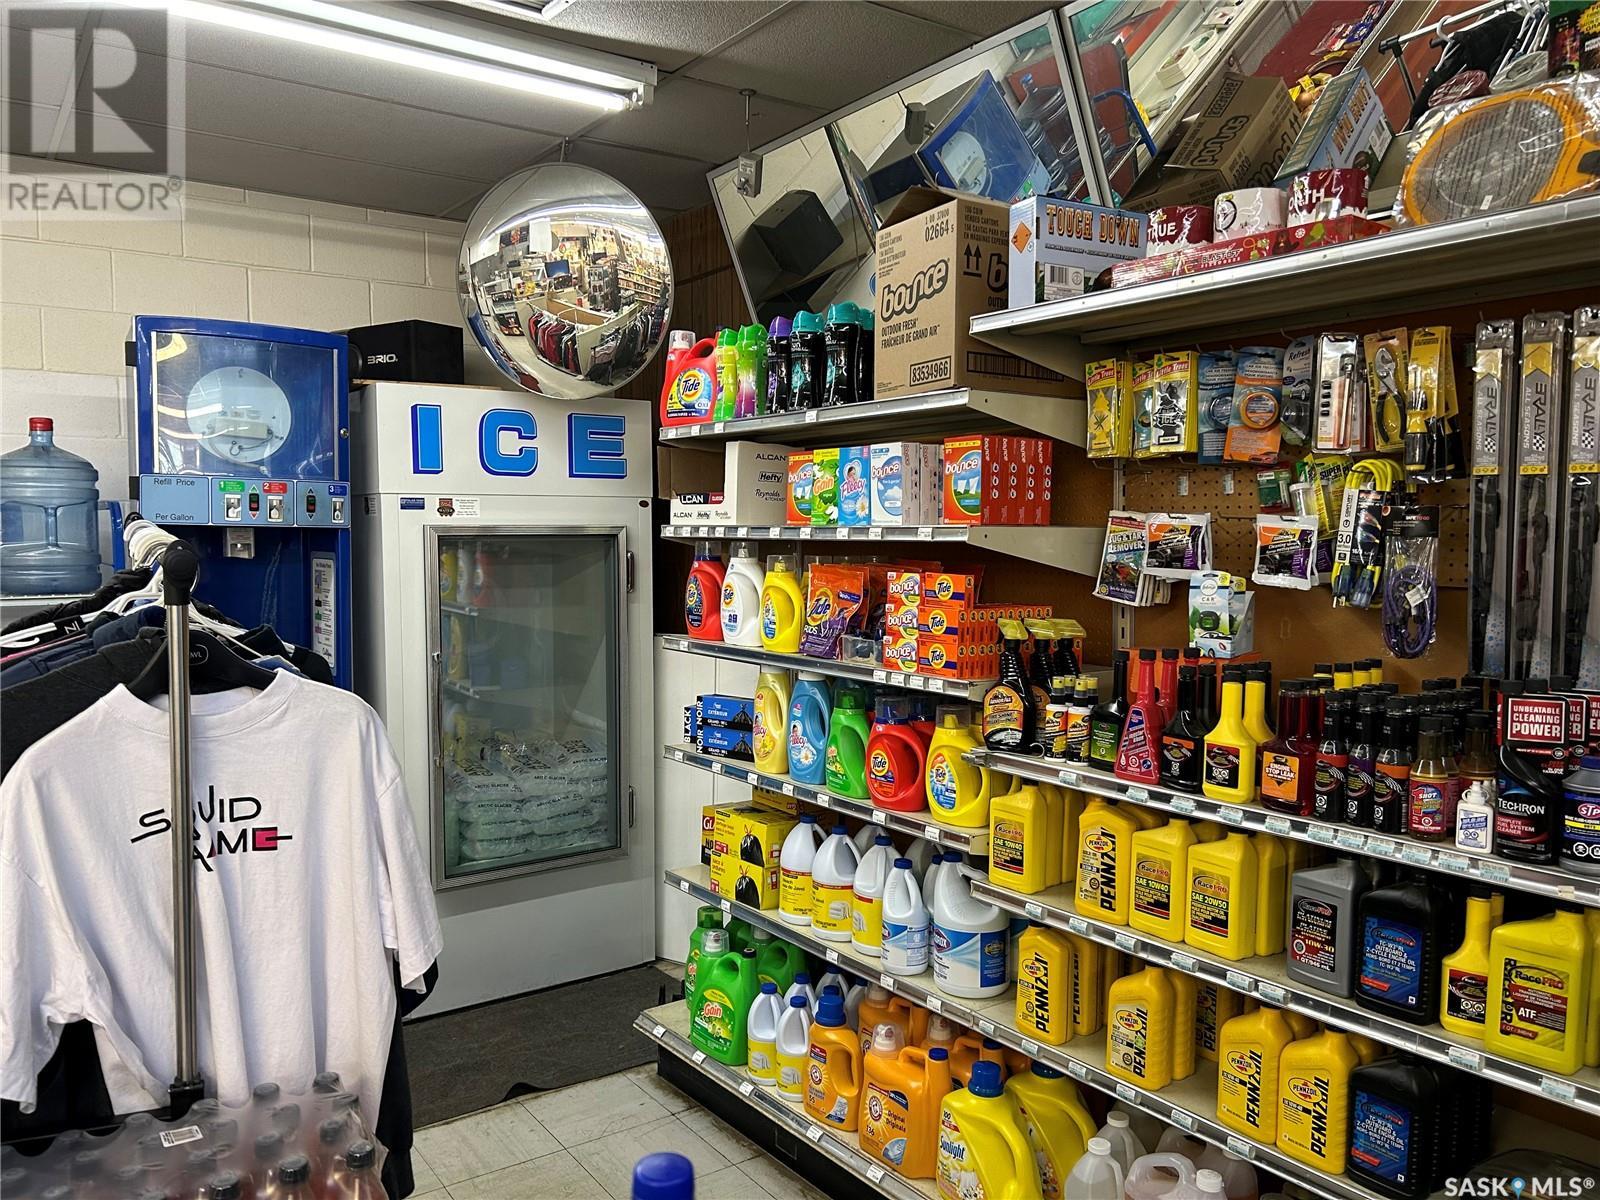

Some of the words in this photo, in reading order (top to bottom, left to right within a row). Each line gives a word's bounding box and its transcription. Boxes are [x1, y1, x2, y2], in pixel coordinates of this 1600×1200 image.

[925, 219, 949, 242] 02664
[1047, 204, 1092, 241] TOUCH
[1100, 217, 1140, 248] DOWN
[881, 259, 949, 323] bounce
[881, 322, 901, 337] OUTDOOR
[902, 319, 917, 332] FRESH
[905, 334, 911, 342] DE
[912, 329, 927, 342] GRAND
[928, 326, 938, 337] AIR
[912, 361, 948, 383] 83534966
[1172, 363, 1189, 372] Trees
[682, 379, 700, 396] Tide
[411, 403, 627, 478] ICE
[755, 453, 786, 462] ALCAN
[871, 462, 899, 478] bounce
[945, 458, 978, 474] bounce
[1319, 464, 1341, 480] SUPER
[153, 477, 172, 487] Refill
[176, 478, 195, 487] Price
[759, 472, 783, 482] Hefty
[788, 470, 812, 483] bounce
[263, 482, 270, 490] 2
[329, 485, 335, 493] 3
[813, 477, 834, 494] Gain
[840, 478, 866, 498] Fleecy
[755, 489, 781, 498] Reynolds
[155, 513, 169, 521] Per
[170, 513, 194, 521] Gallon
[1337, 534, 1352, 544] 3.0
[687, 588, 697, 600] Tide
[889, 580, 914, 594] bounce
[937, 582, 951, 595] Tide
[723, 588, 734, 601] Tide
[808, 598, 831, 617] Tide
[887, 612, 913, 627] bounce
[930, 616, 945, 629] Tide
[885, 645, 910, 659] bounce
[930, 649, 945, 662] Tide
[1513, 705, 1560, 715] UNBEATABLE
[1513, 713, 1560, 724] CLEANING
[684, 709, 692, 743] BLACK
[1512, 722, 1561, 737] POWER
[872, 755, 887, 769] Tide
[1266, 767, 1280, 775] STOP
[1281, 770, 1295, 778] LEAK
[1498, 797, 1545, 815] TECHRON
[1581, 803, 1600, 816] STP
[131, 785, 262, 843] SUID
[1497, 816, 1522, 825] COMPLETE
[1497, 826, 1522, 835] CLEANER
[1510, 823, 1535, 832] SYSTEM
[993, 837, 1004, 846] SAE
[190, 827, 292, 872] AME
[1135, 877, 1147, 886] SAE
[1192, 893, 1204, 902] SAE
[1204, 896, 1227, 909] 20W50
[1305, 939, 1335, 953] 10W-30
[1375, 945, 1402, 957] OUTBOARD
[1366, 947, 1387, 957] 2-CYCLE
[1388, 954, 1406, 964] ENGINE
[703, 1002, 722, 1018] Gain
[1518, 1007, 1537, 1019] ATF
[1230, 1057, 1253, 1069] PENNZOIL
[1292, 1083, 1318, 1096] PENNZOIL
[887, 1110, 905, 1123] Original
[1365, 1119, 1392, 1133] OUTBOARD
[1356, 1121, 1377, 1133] 2-CYCLE
[1378, 1129, 1395, 1141] ENGINE
[1396, 1137, 1405, 1146] OIL
[940, 1135, 965, 1160] Sunlight
